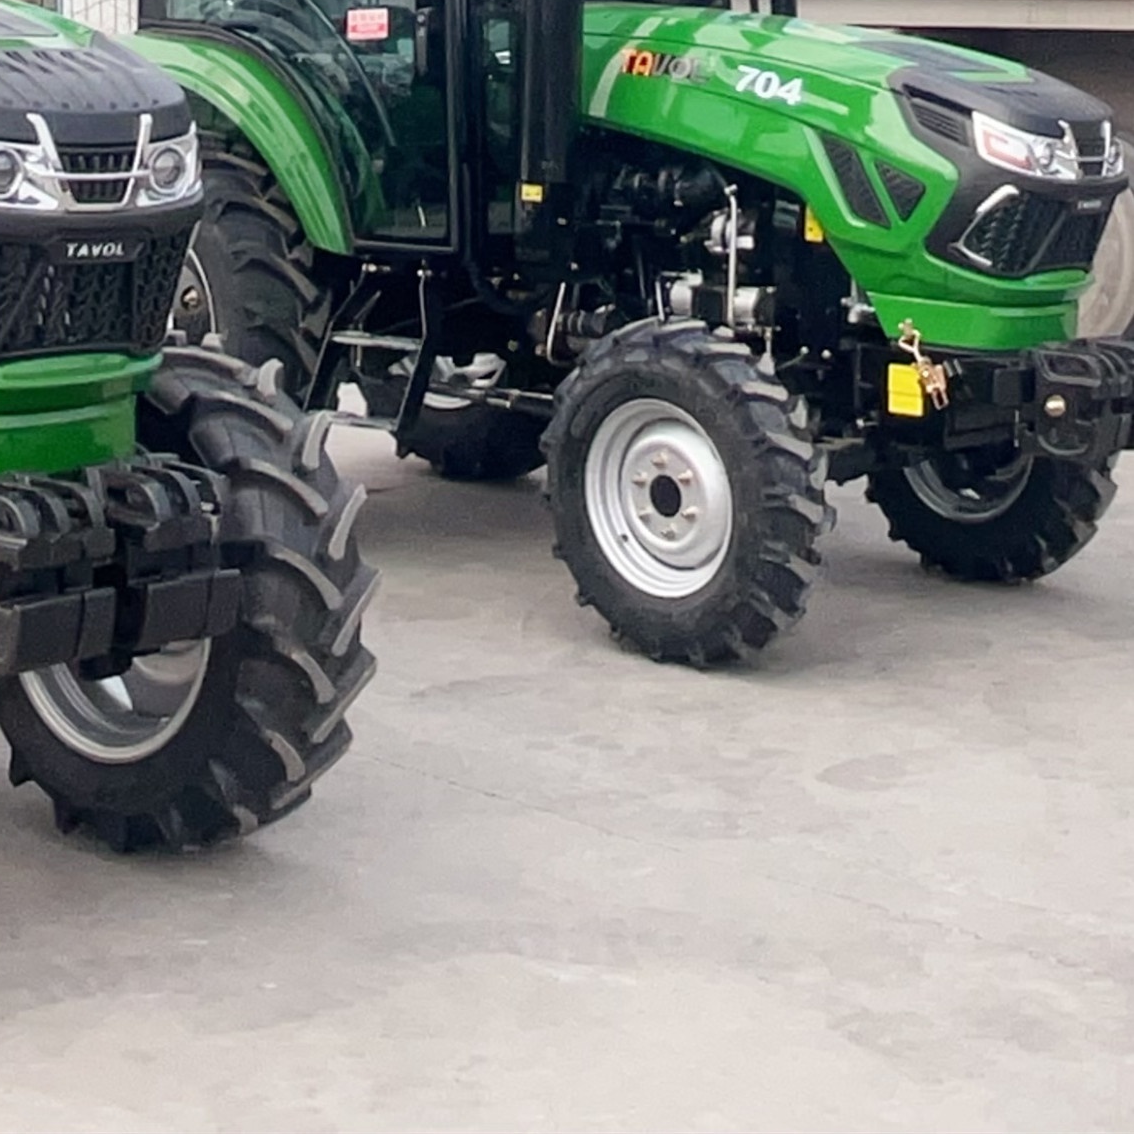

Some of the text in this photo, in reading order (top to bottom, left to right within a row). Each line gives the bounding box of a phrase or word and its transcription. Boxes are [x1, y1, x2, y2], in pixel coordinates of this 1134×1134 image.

[621, 47, 803, 106] TAVOL 704
[66, 242, 124, 258] TAVOL
